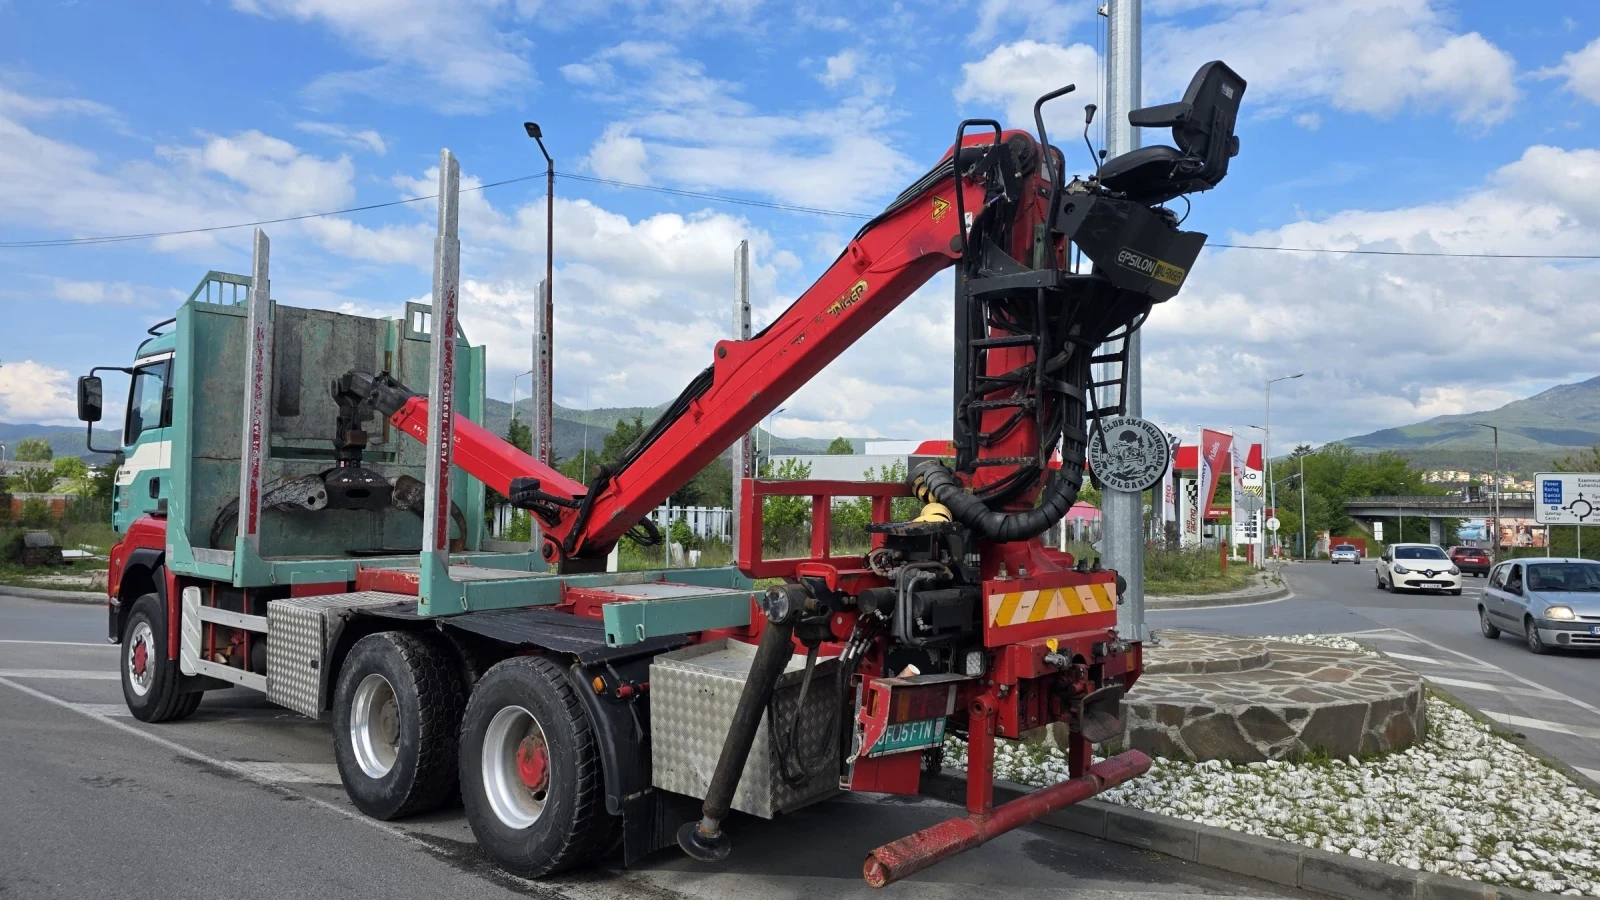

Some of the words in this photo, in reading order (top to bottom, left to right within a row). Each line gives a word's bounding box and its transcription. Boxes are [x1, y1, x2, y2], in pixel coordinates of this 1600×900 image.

[1117, 250, 1156, 273] EPSILON
[1102, 419, 1125, 433] CLUB
[1125, 418, 1142, 428] 4X4
[1141, 423, 1165, 467] VELINGRAD
[1209, 442, 1220, 460] fuels
[1103, 473, 1156, 489] BULGARIA
